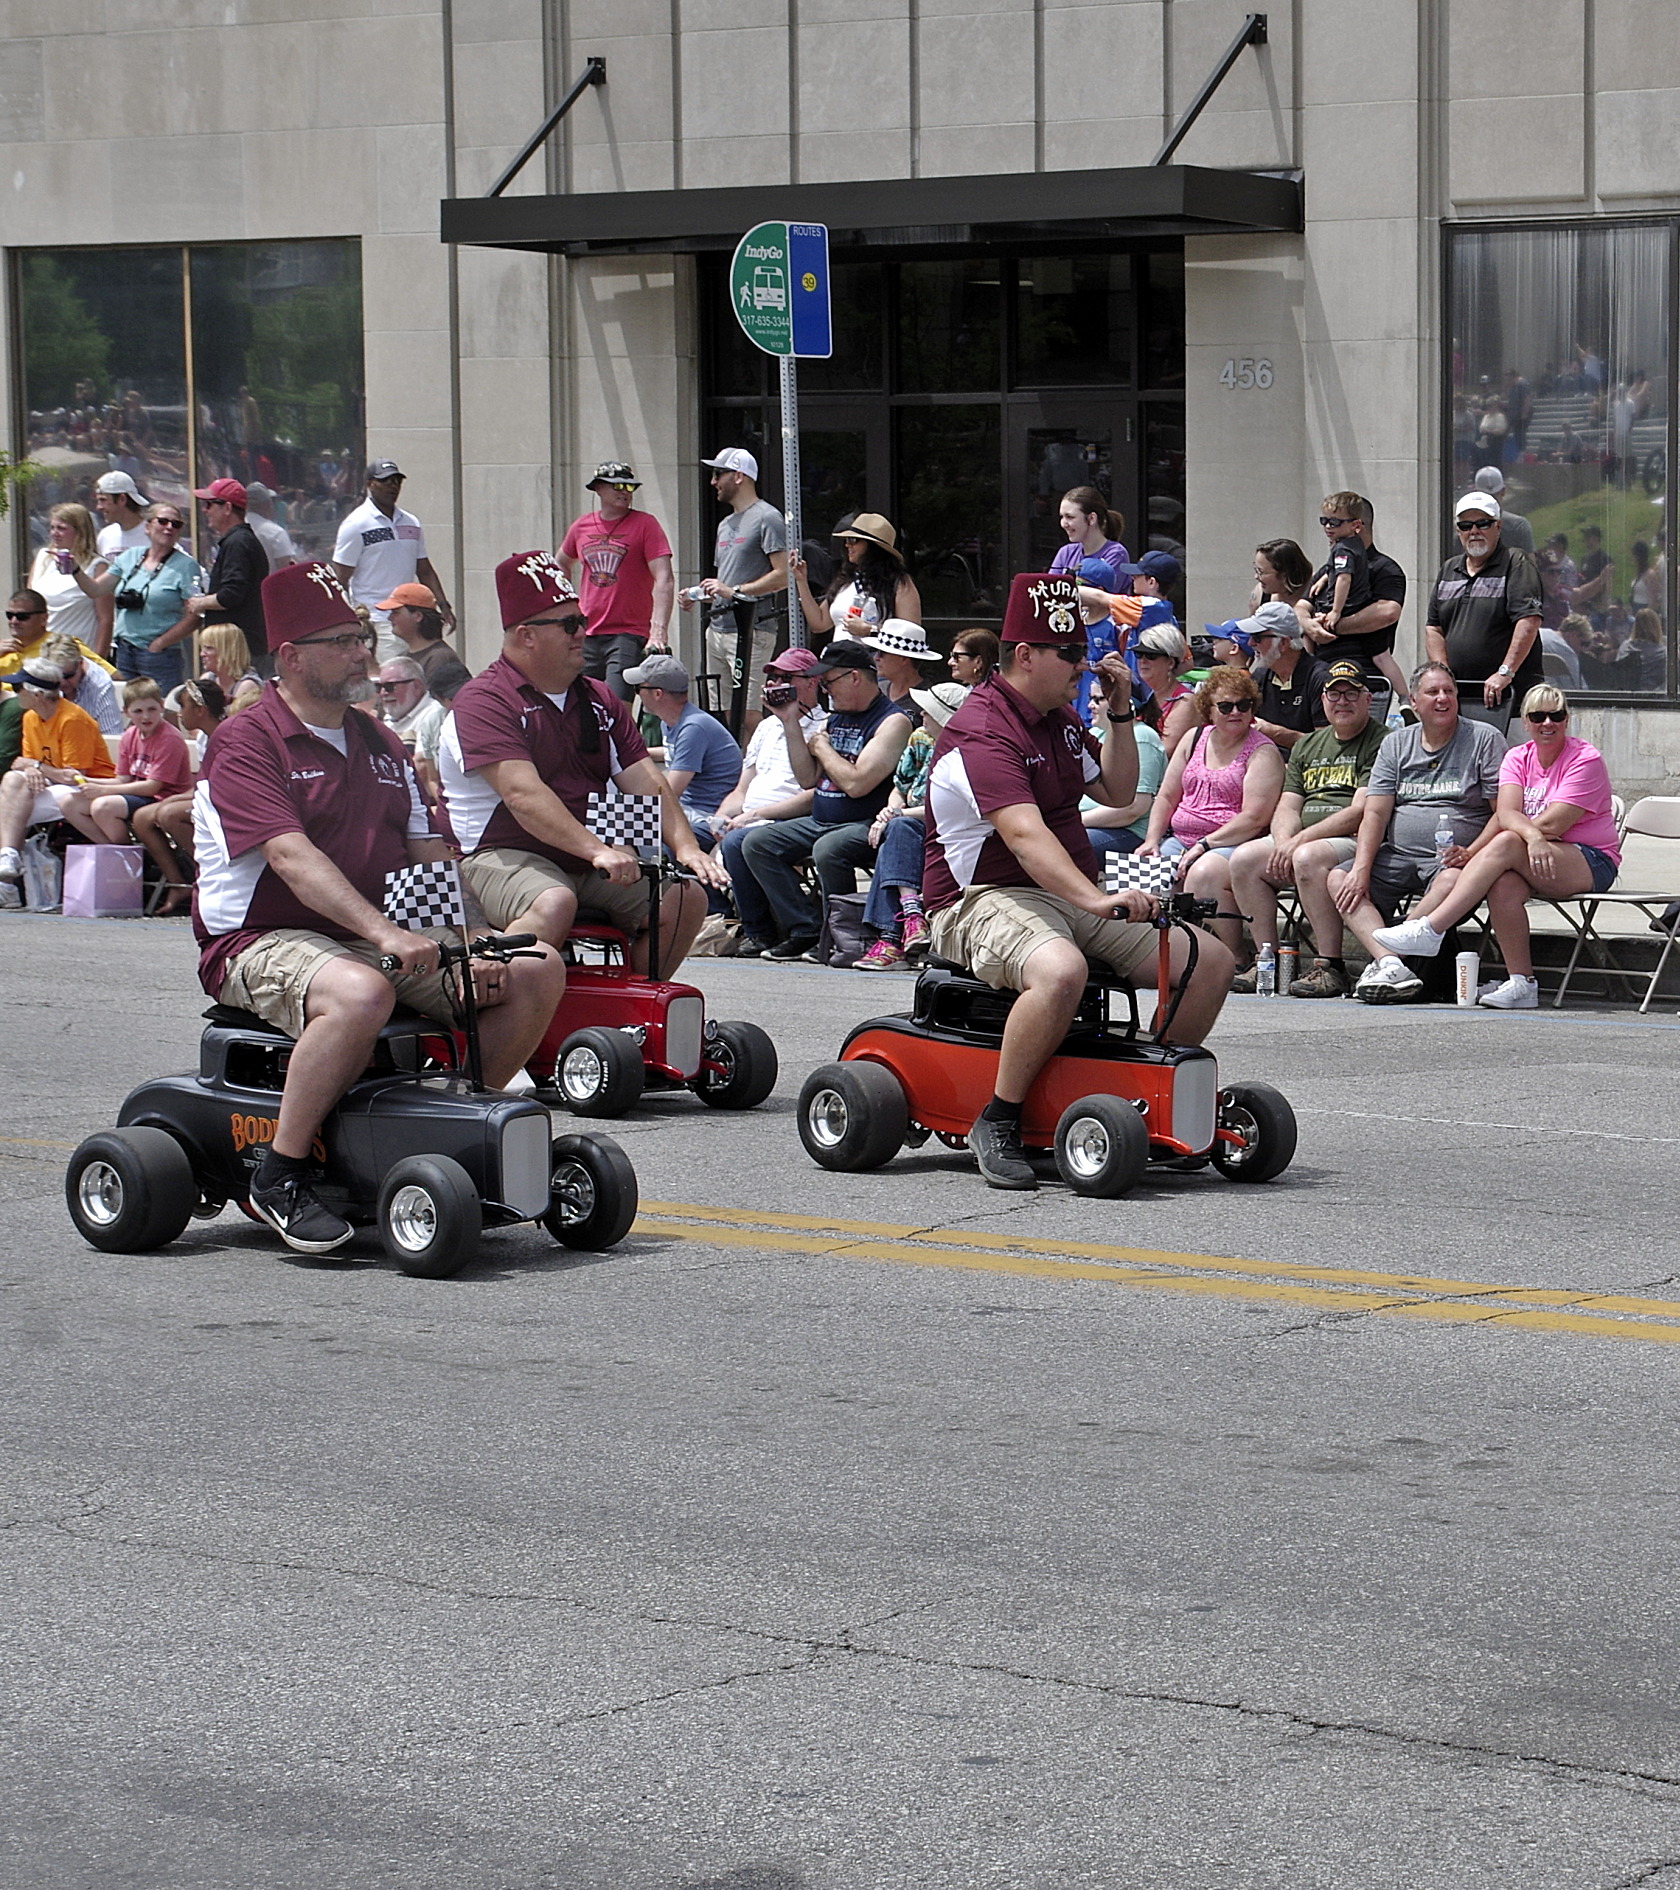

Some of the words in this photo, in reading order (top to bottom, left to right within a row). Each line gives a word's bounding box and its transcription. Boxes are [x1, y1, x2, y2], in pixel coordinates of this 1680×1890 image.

[793, 226, 822, 237] ROUTES
[745, 245, 784, 260] IndyGo
[802, 276, 815, 289] 39
[742, 314, 790, 328] 317-635-3344
[1219, 359, 1274, 390] 456
[732, 657, 744, 689] veo
[1398, 782, 1432, 795] NOTRE
